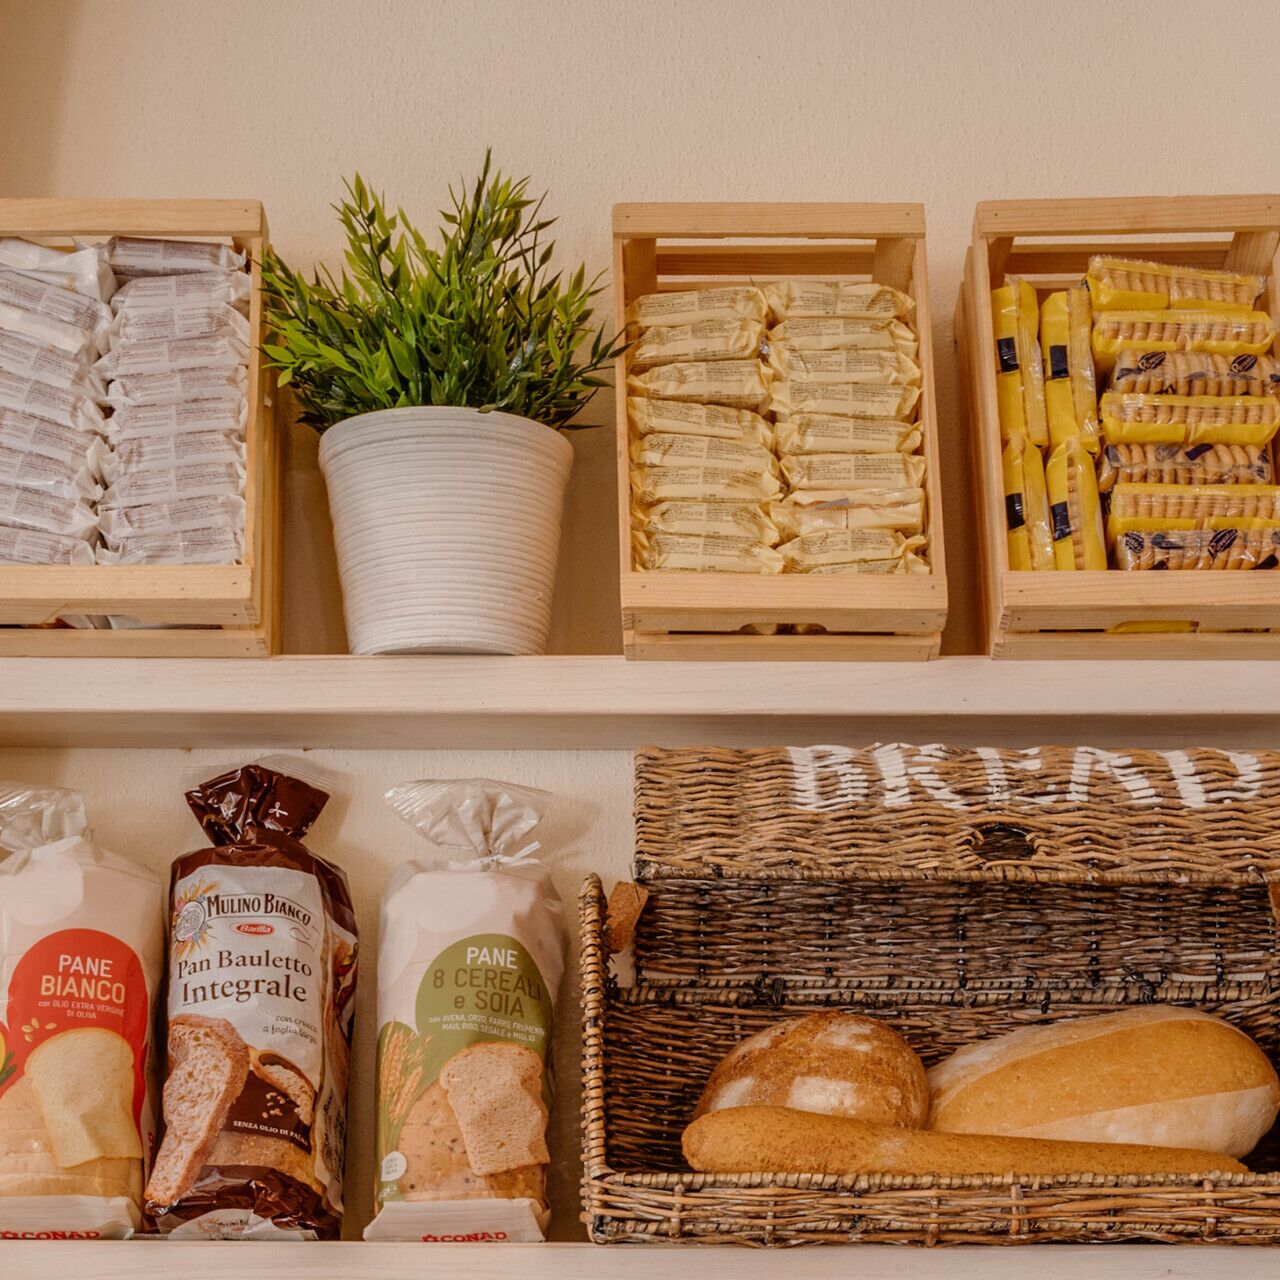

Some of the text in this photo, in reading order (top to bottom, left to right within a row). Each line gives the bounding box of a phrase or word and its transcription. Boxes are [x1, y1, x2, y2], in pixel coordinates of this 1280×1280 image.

[784, 742, 1264, 811] BREAD
[207, 893, 312, 926] MULINO BIANCO
[239, 924, 271, 933] Barilla
[58, 954, 113, 978] PANE
[177, 949, 313, 980] Pan Bauletto
[466, 946, 518, 969] PANE
[40, 974, 126, 1005] BIANCO
[181, 973, 308, 1007] Integrale
[432, 968, 542, 1002] 8 CEREALI
[52, 1000, 70, 1008] OLIO
[71, 1001, 95, 1010] EXTRA
[67, 1009, 97, 1020] DI OLIVA
[453, 990, 525, 1019] e SOIA
[263, 1025, 270, 1033] a
[233, 1120, 258, 1130] SENZA
[259, 1125, 279, 1134] OLIO
[280, 1128, 289, 1136] DI
[440, 1231, 508, 1243] CONAD
